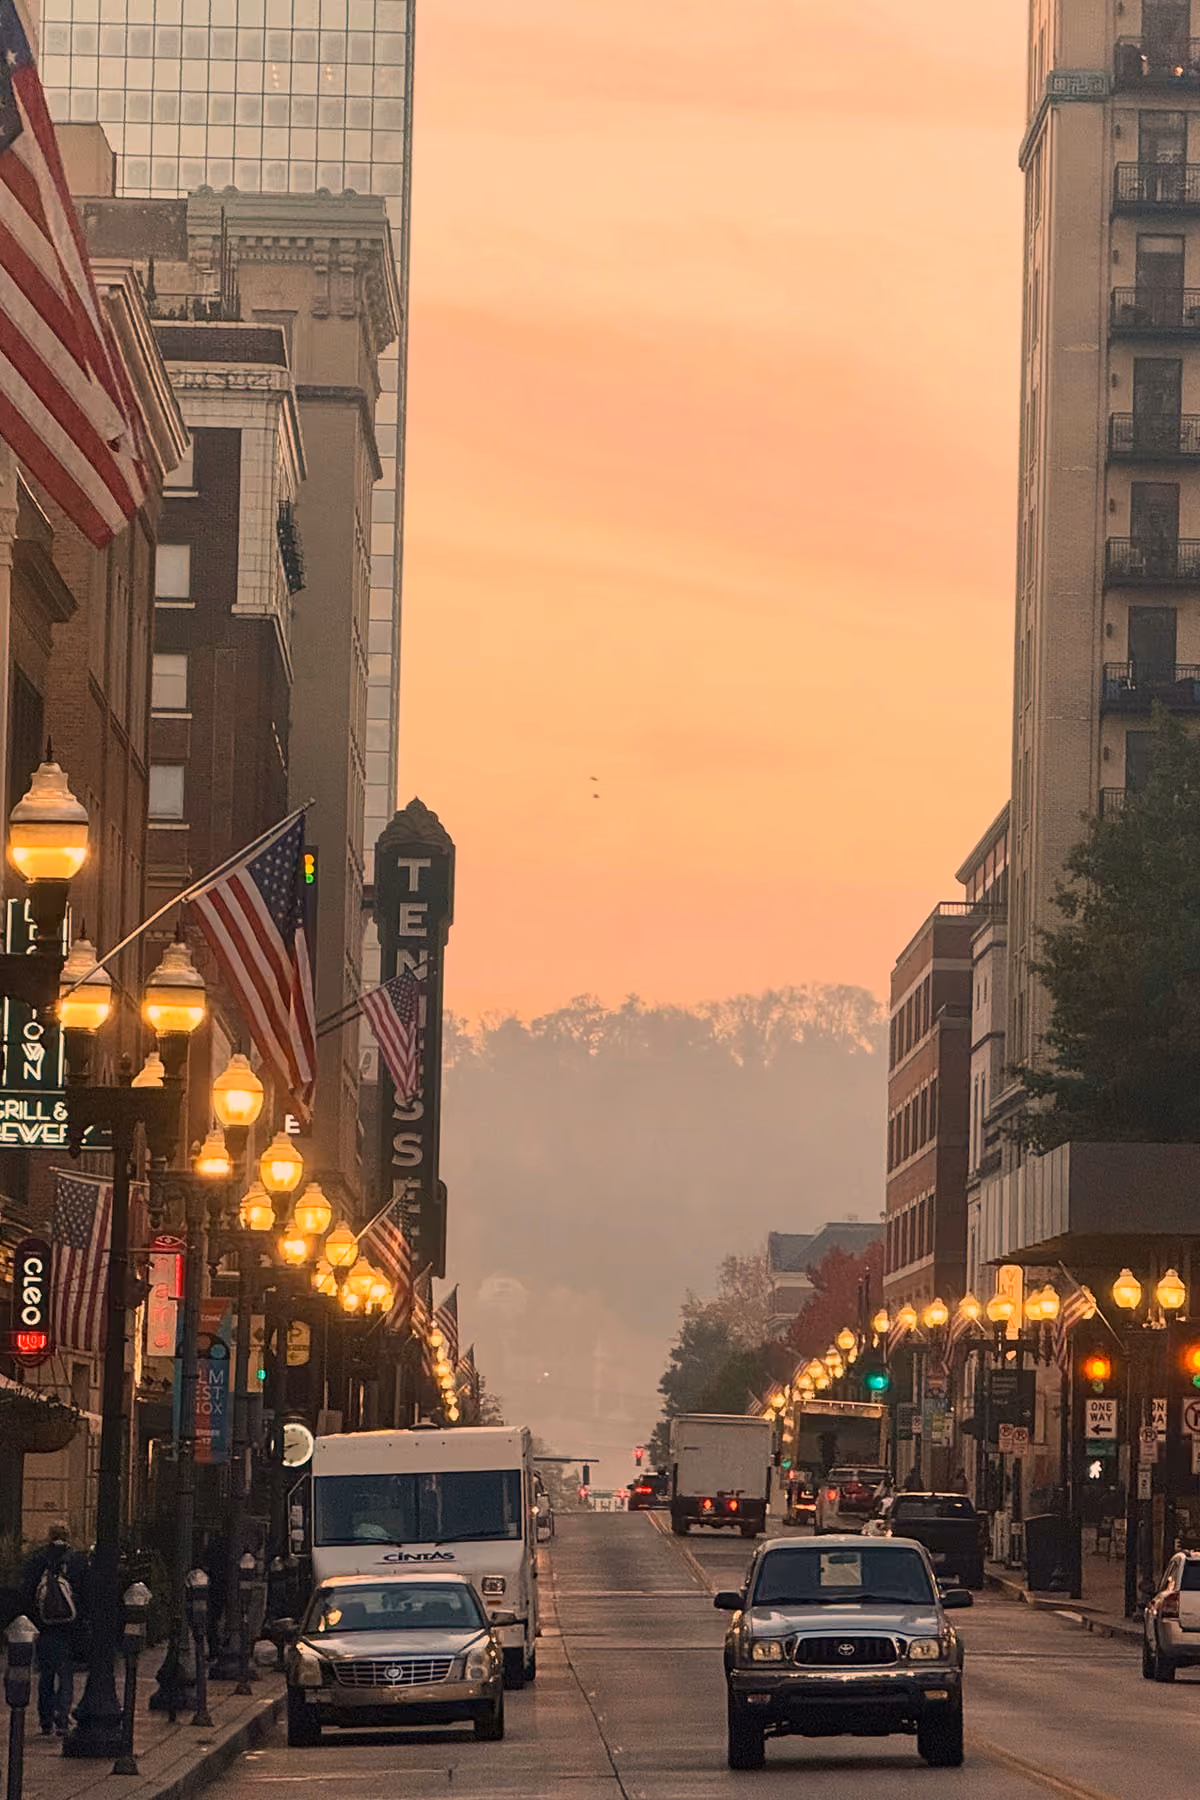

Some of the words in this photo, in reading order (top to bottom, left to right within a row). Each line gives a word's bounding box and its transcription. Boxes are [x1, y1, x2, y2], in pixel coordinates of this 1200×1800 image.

[53, 1101, 69, 1121] &
[1091, 1402, 1112, 1412] ONE
[1090, 1413, 1112, 1422] WAY
